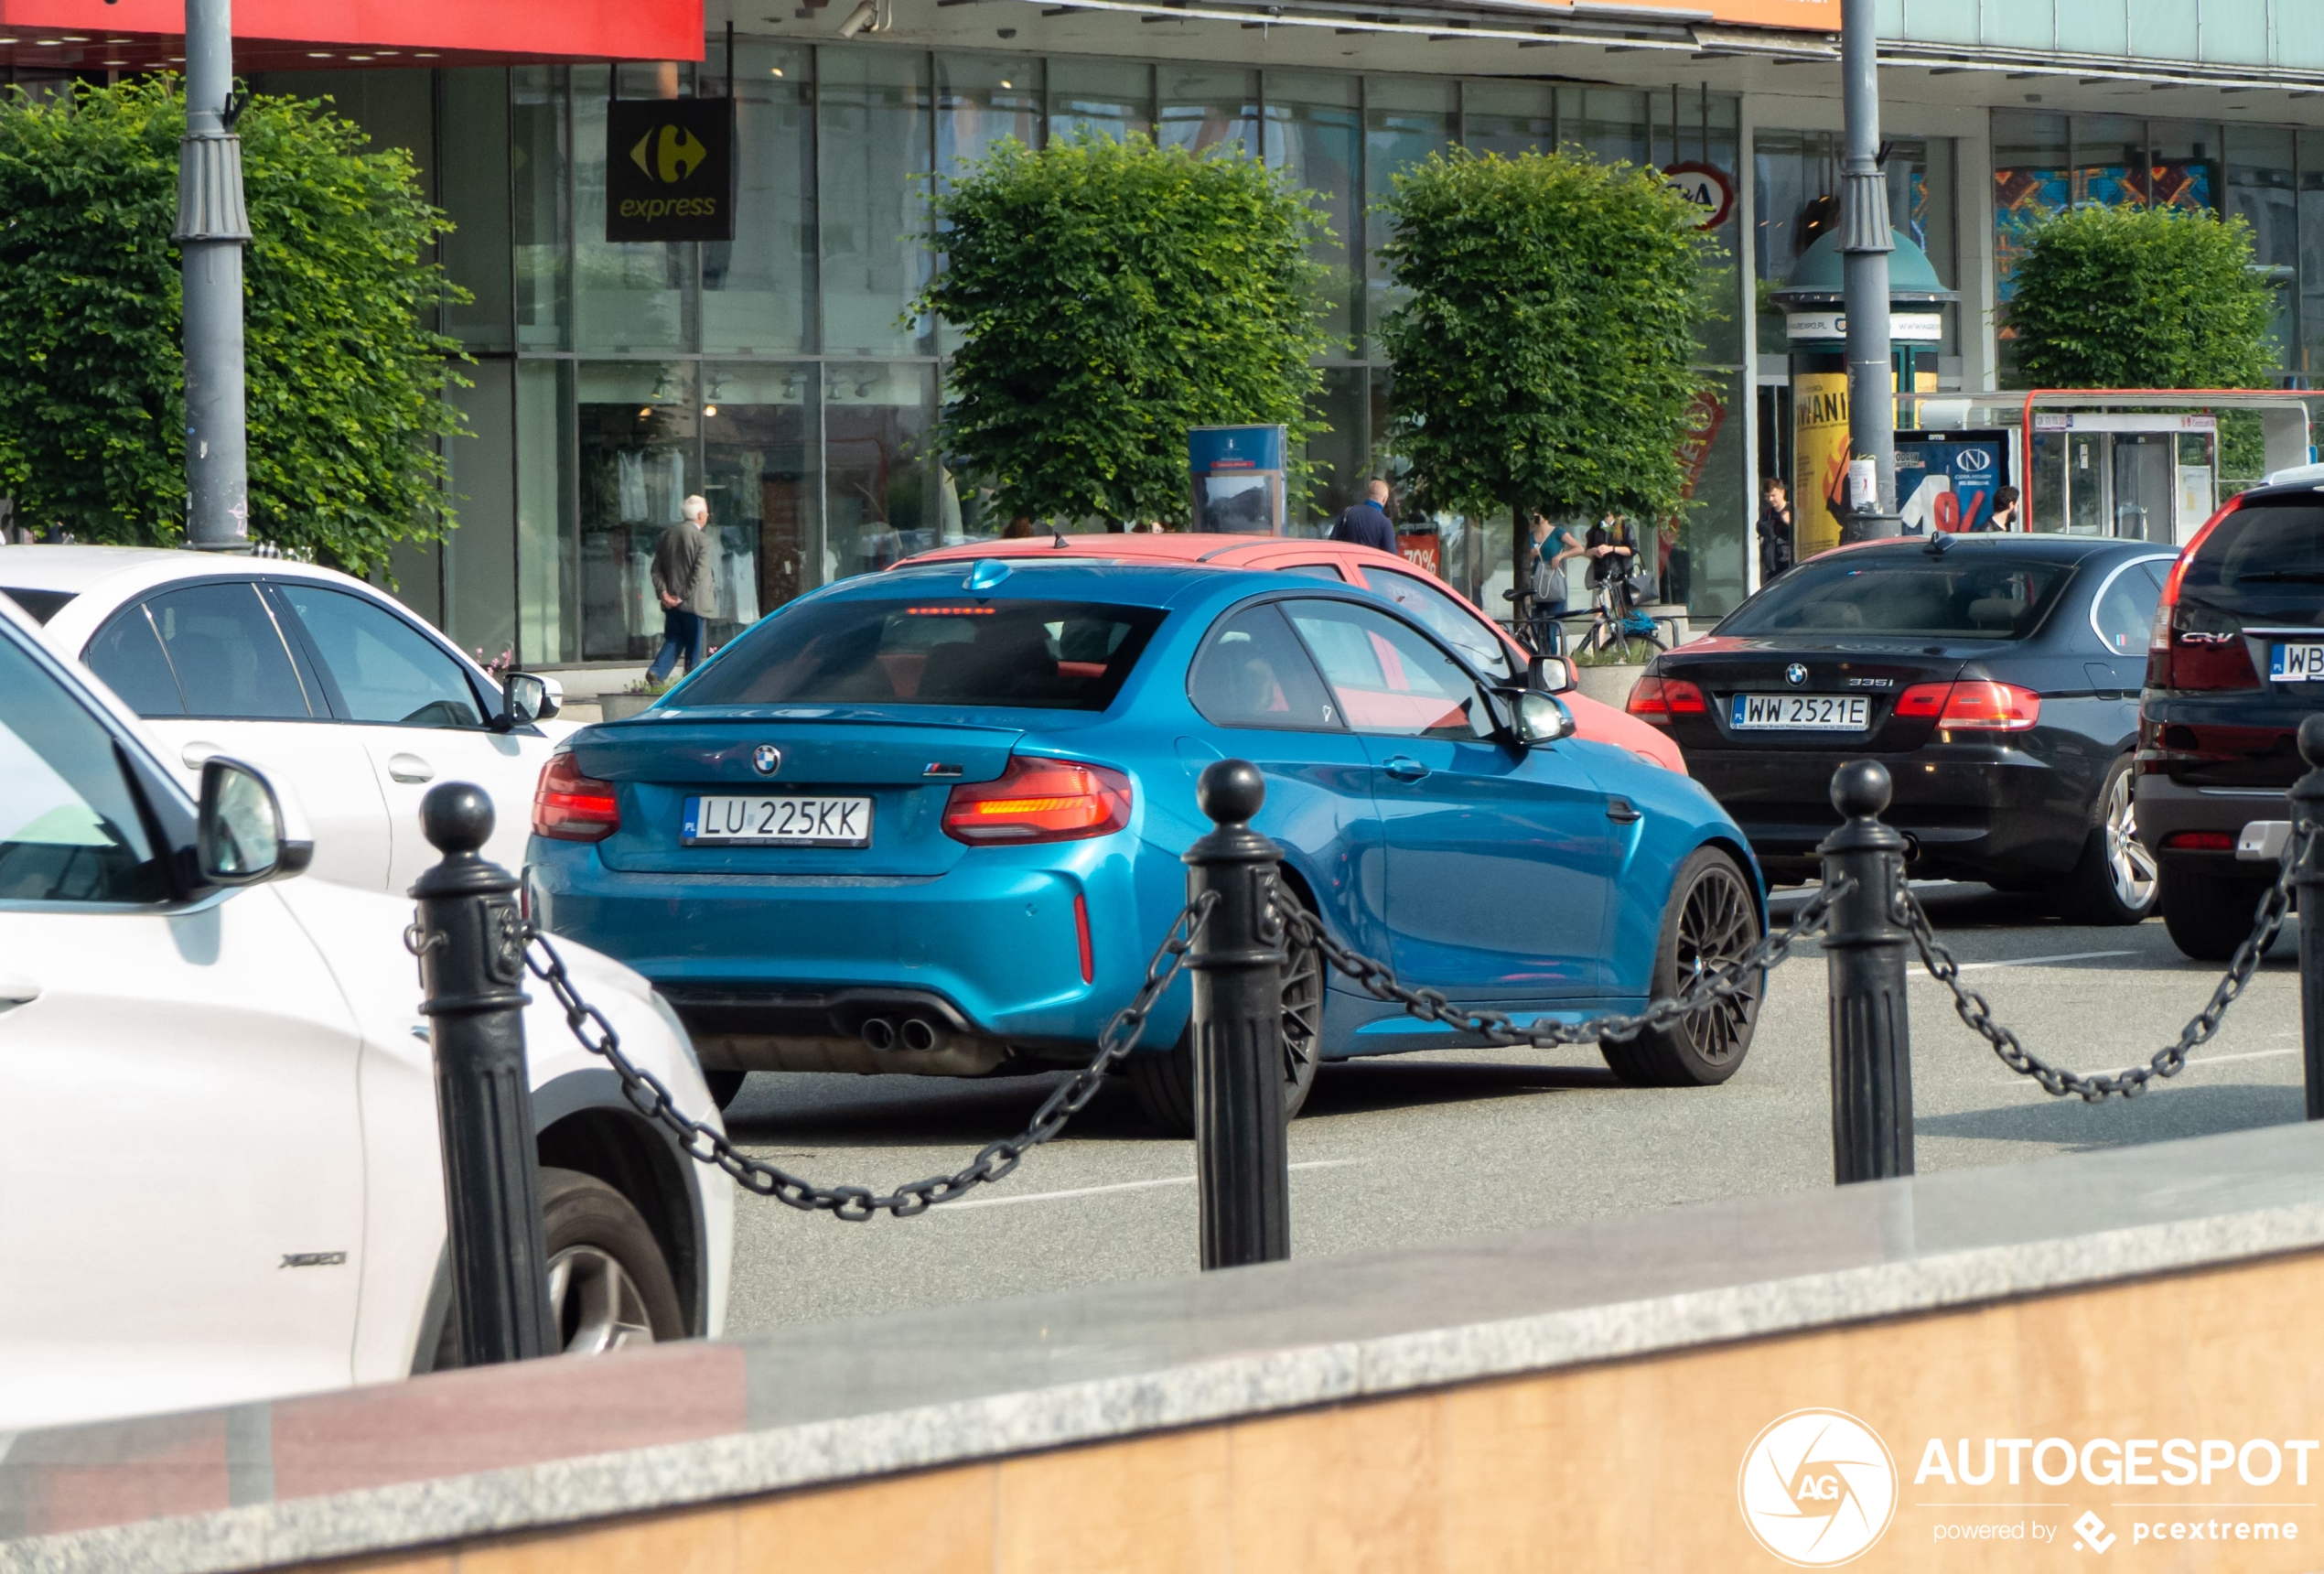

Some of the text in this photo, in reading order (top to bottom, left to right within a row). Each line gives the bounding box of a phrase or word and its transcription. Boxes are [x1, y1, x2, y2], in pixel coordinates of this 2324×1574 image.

[619, 197, 715, 221] express
[1749, 698, 1865, 723] WW 2521E
[685, 823, 695, 832] PL
[705, 801, 861, 836] LU 225KK
